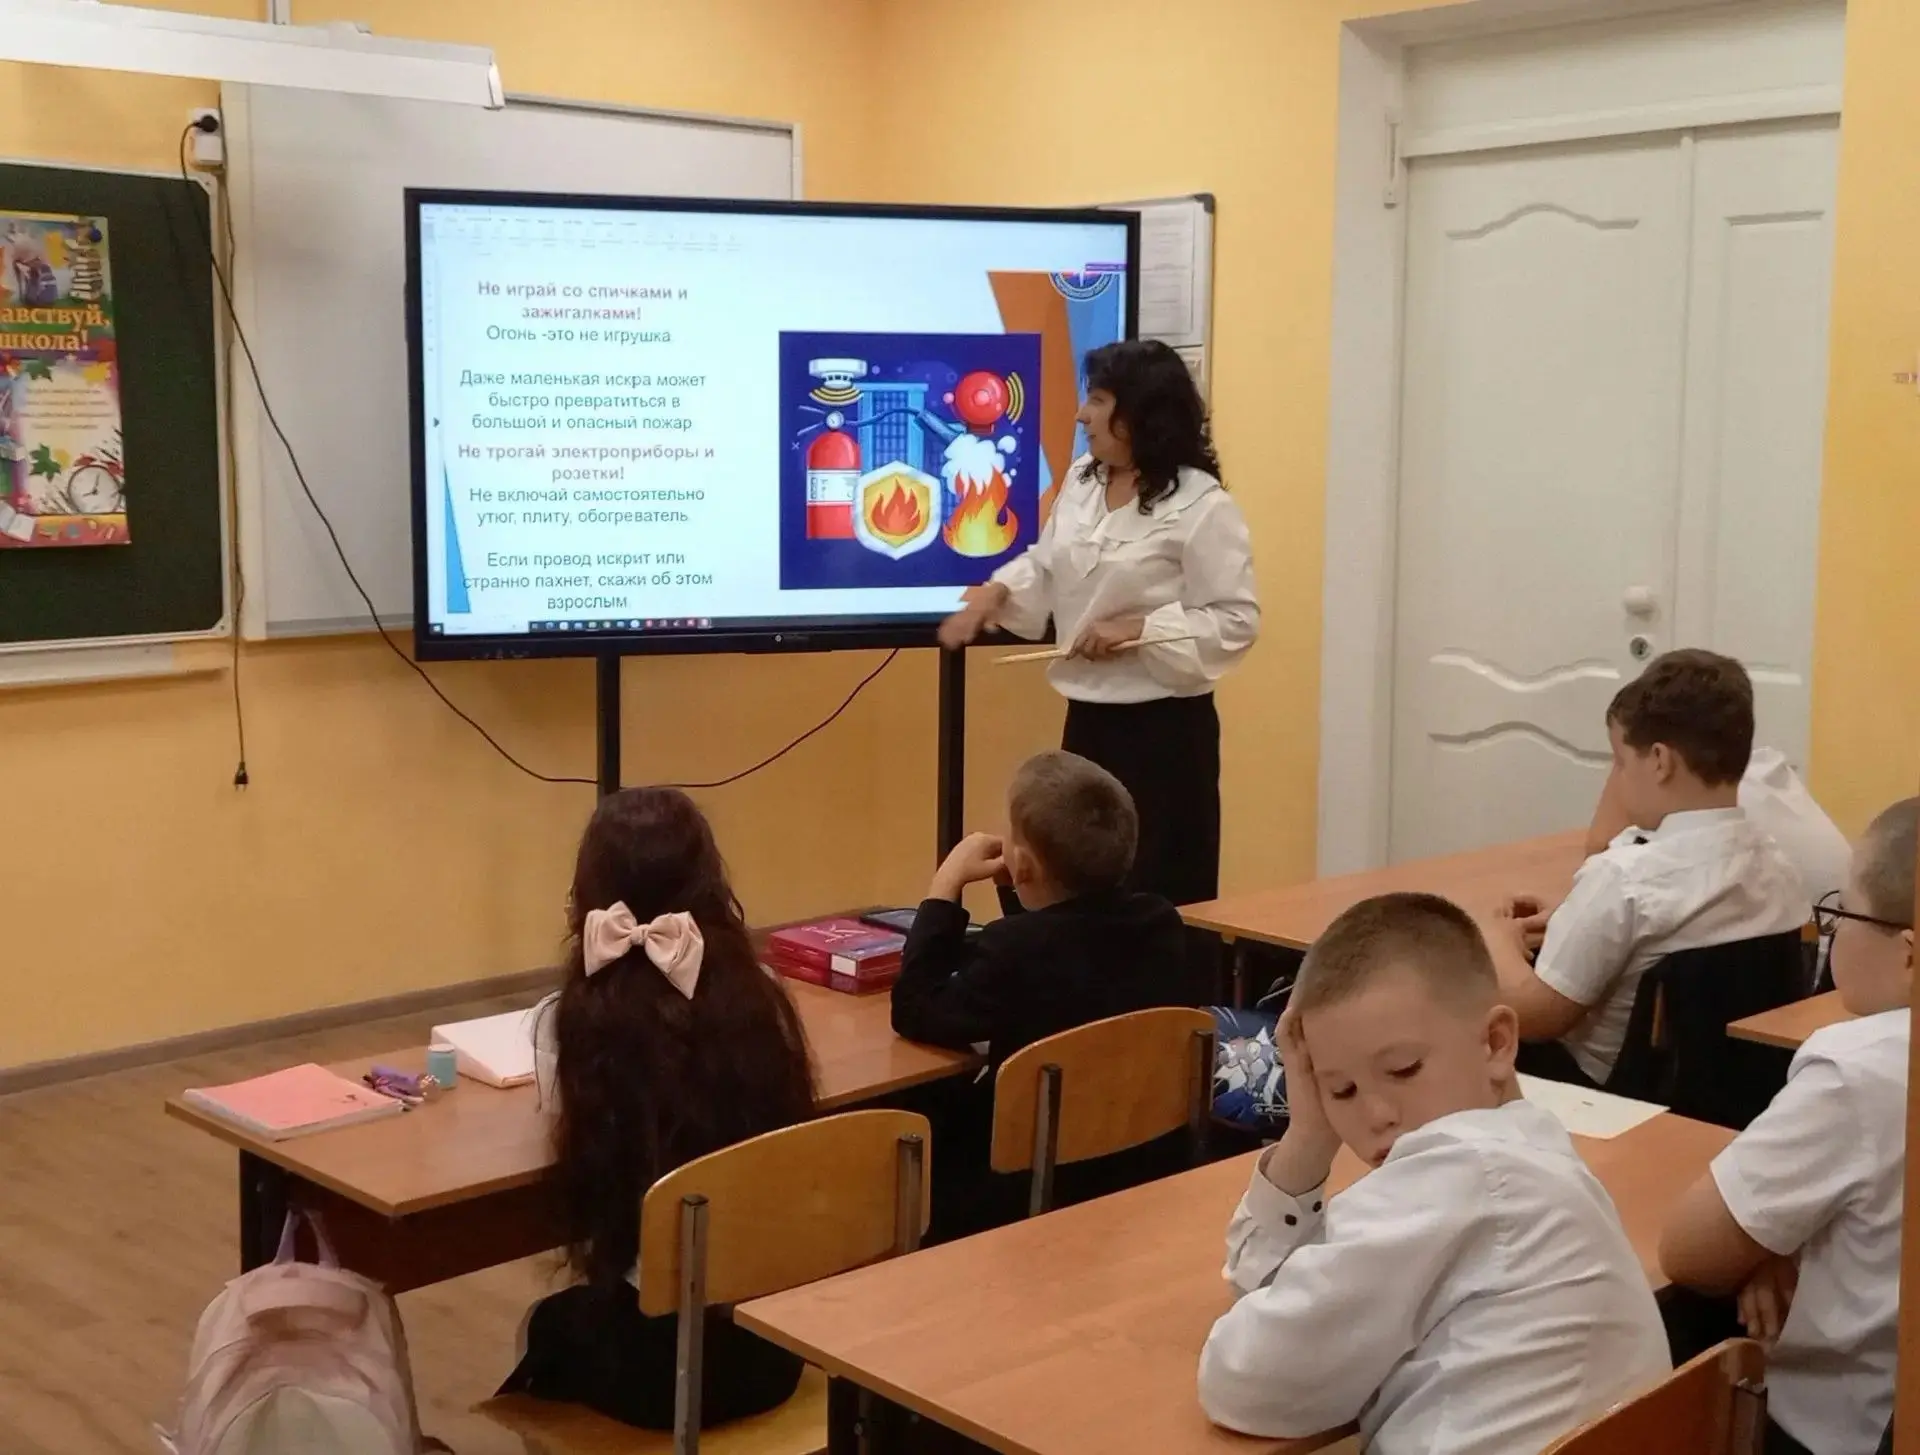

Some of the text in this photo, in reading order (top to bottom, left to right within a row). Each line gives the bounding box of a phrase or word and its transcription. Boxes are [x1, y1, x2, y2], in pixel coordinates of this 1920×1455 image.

[477, 280, 688, 301] Не играй со спичками и
[521, 307, 642, 321] зажигалками!
[0, 330, 89, 351] школа!
[486, 325, 537, 341] Огонь
[579, 330, 598, 342] не
[603, 330, 671, 345] игрушка
[460, 370, 706, 389] Даже маленькая искра может
[488, 391, 681, 409] быстро превратиться в
[471, 413, 692, 431] большой и опасный пожар
[458, 443, 715, 463] Не трогай электроприборы и
[551, 467, 624, 482] розетки!
[469, 487, 705, 502] Не включай самостоятельно
[477, 509, 689, 527] утюг, плиту, обогреватель
[487, 552, 685, 569] Если провод искрит или
[462, 570, 713, 590] странно пахнет, скажи об этом
[547, 596, 628, 611] взрослым
